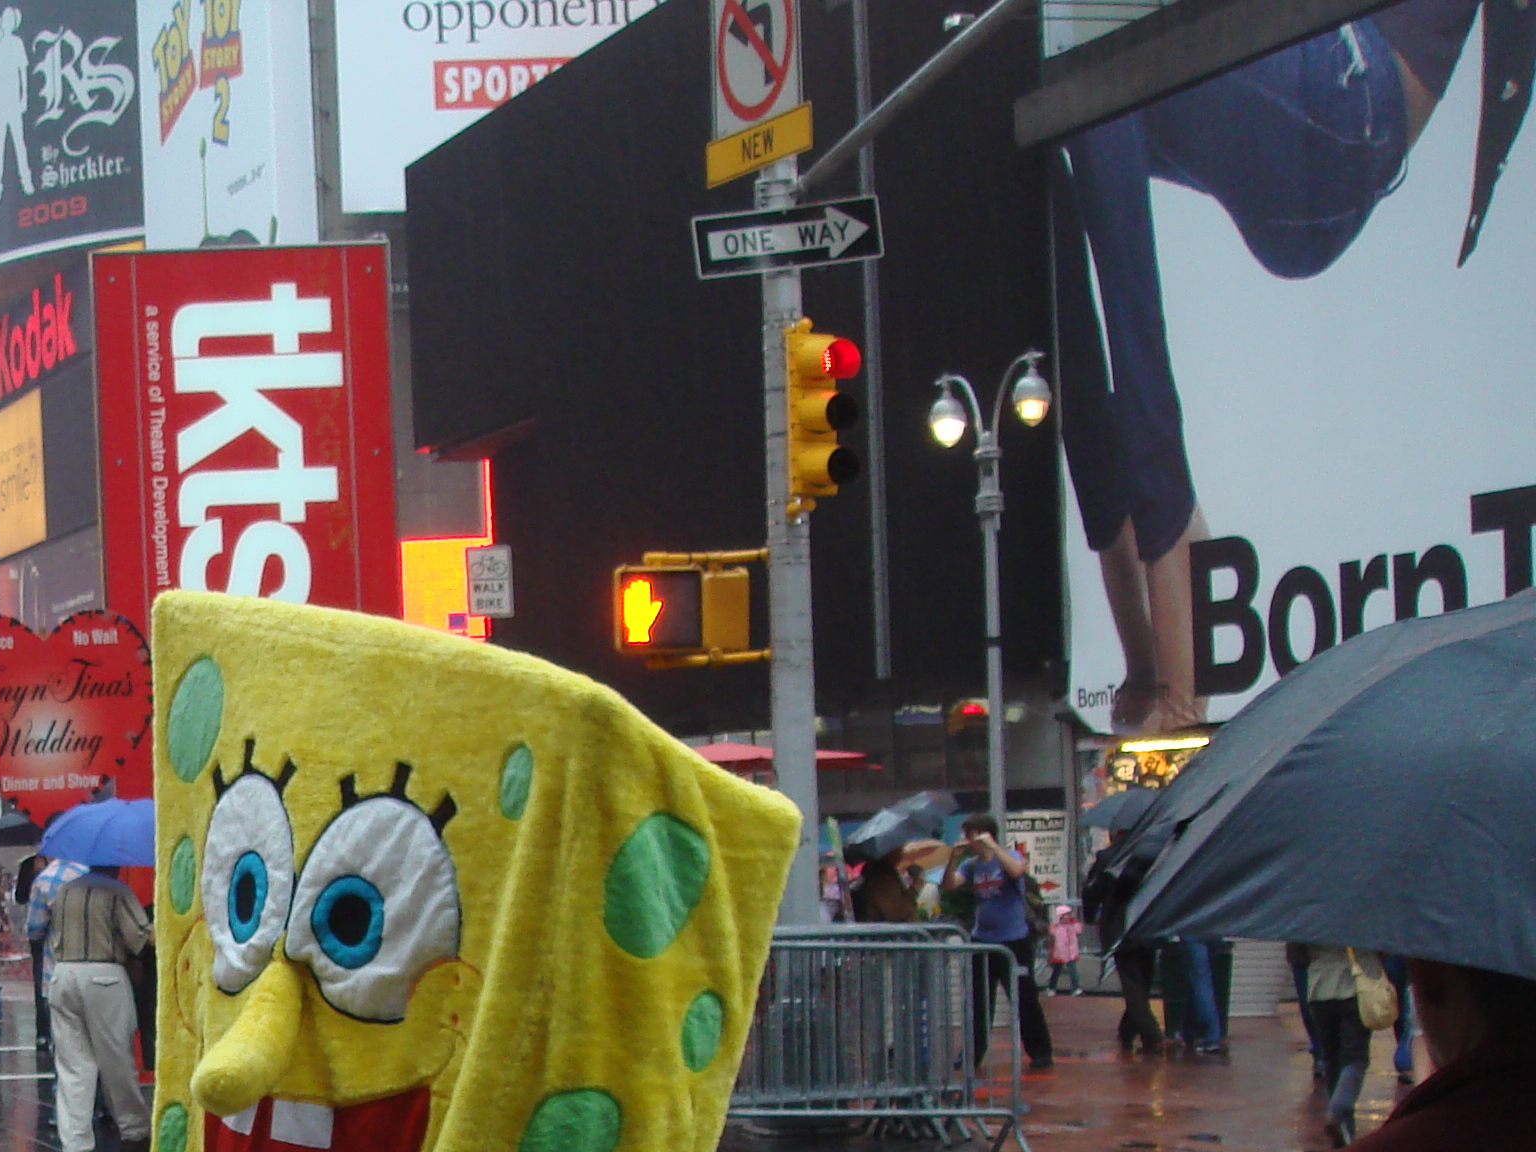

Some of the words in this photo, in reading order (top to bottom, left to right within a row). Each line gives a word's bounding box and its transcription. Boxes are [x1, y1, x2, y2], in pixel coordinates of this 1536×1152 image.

[403, 0, 632, 44] opponent
[442, 63, 563, 103] SPORT
[213, 72, 230, 147] 2
[740, 127, 775, 163] NEW
[41, 156, 127, 190] Sheckler
[17, 195, 88, 229] 2009
[723, 229, 775, 256] ONE
[797, 219, 850, 249] WAY
[145, 304, 159, 317] a
[145, 320, 162, 382] service
[148, 385, 165, 404] of
[149, 405, 166, 473] Theatre
[171, 281, 344, 605] tkts
[151, 475, 172, 587] Development
[73, 631, 89, 646] No
[91, 629, 119, 645] Wait
[1, 776, 39, 792] Dinner
[43, 774, 65, 790] and
[67, 773, 101, 789] Show
